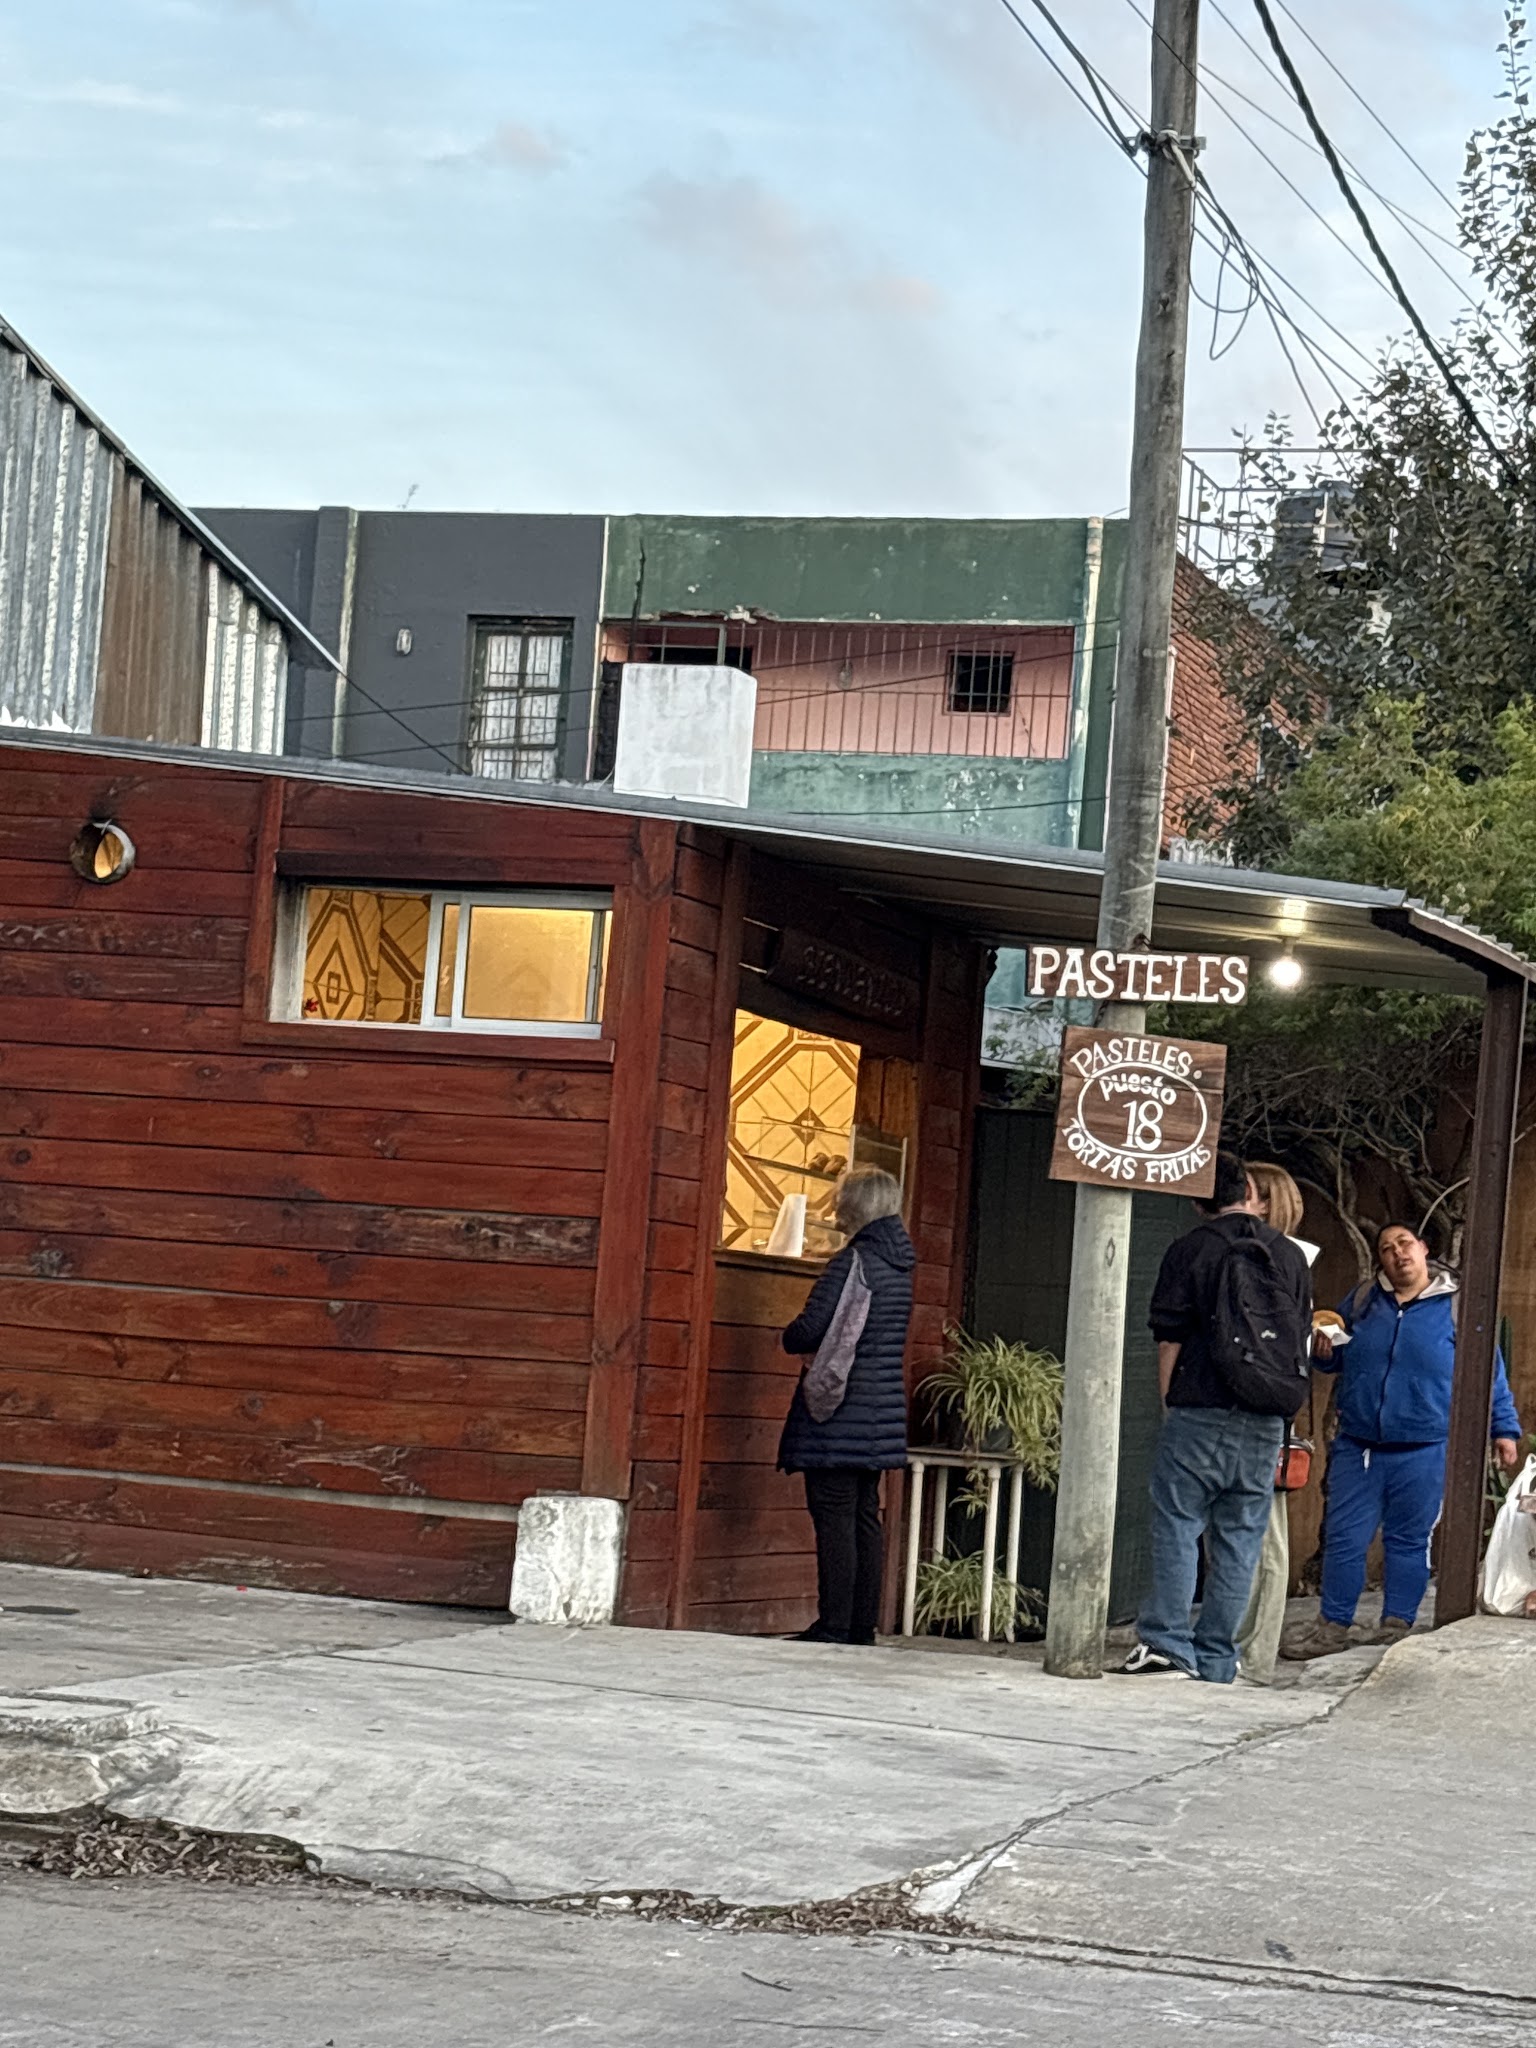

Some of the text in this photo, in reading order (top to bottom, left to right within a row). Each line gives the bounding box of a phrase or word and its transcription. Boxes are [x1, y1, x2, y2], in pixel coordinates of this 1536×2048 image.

[1030, 947, 1248, 1004] PASTELES
[1061, 1117, 1212, 1183] TORTAS FRITAS
[1122, 1100, 1163, 1151] 18
